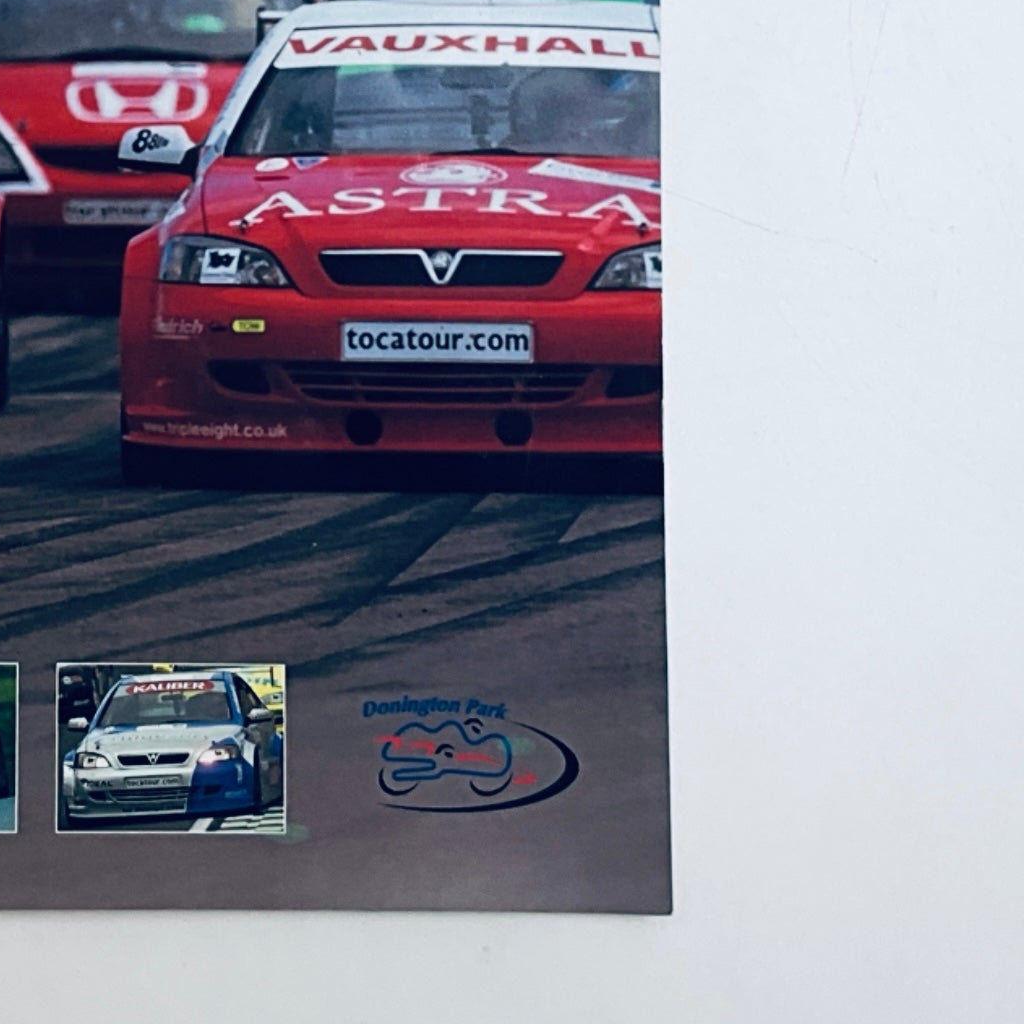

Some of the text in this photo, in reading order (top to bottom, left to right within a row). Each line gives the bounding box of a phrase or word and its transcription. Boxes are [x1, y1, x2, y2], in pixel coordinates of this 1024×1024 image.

[288, 34, 661, 60] VAUXHALL
[228, 186, 661, 230] ASTRA
[345, 323, 530, 354] tocatour.com
[362, 695, 508, 720] Donington Park
